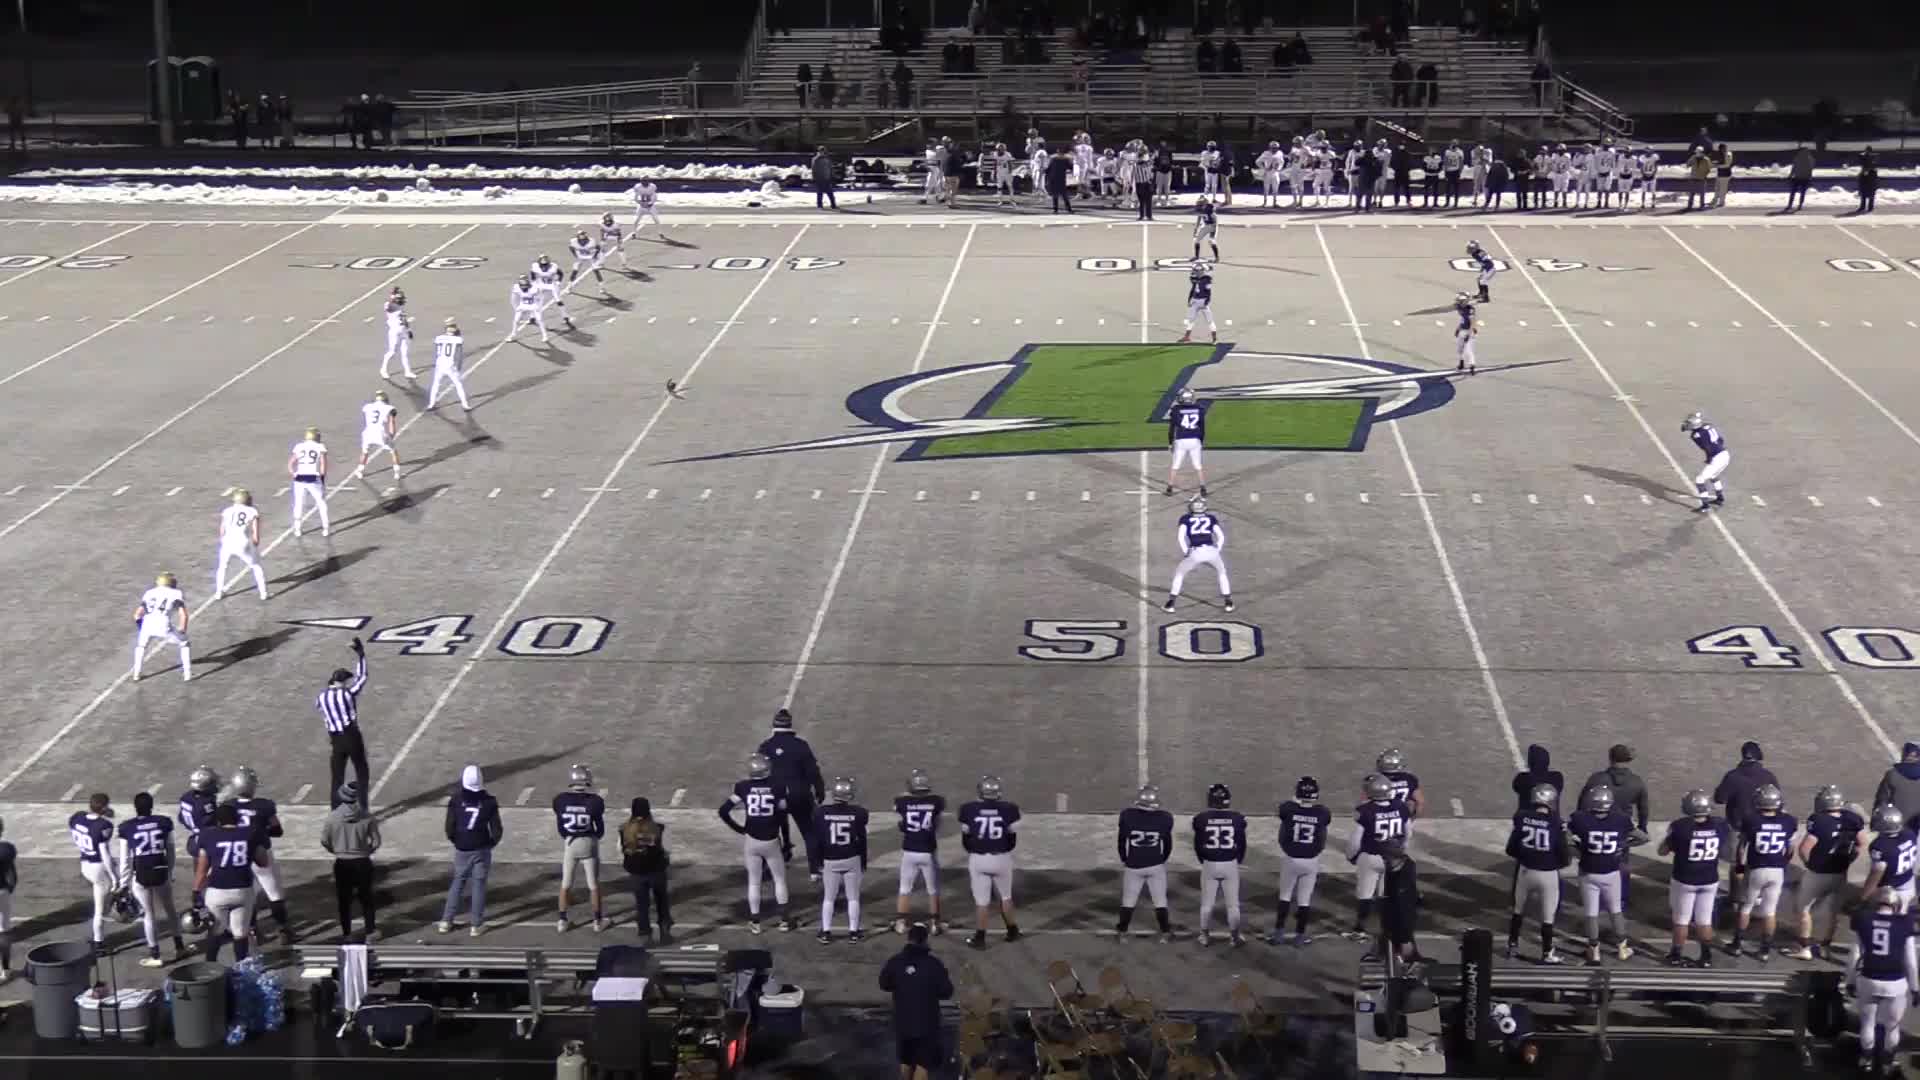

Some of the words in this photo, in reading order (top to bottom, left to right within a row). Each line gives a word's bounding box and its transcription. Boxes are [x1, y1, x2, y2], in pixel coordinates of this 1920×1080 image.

[372, 410, 381, 424] 3
[1180, 414, 1200, 429] 42
[299, 449, 318, 465] 29
[232, 511, 247, 527] 18
[1189, 517, 1211, 534] 22
[367, 615, 615, 656] 40
[1018, 619, 1264, 662] 50
[1686, 626, 1920, 669] 40
[746, 794, 774, 817] 85
[464, 808, 480, 831] 7
[906, 811, 933, 833] 54
[974, 816, 1003, 840] 76
[1375, 817, 1404, 842] 50
[829, 822, 851, 845] 15
[1130, 831, 1159, 847] 23
[1205, 826, 1235, 849] 33
[1292, 822, 1315, 844] 13
[1522, 826, 1550, 852] 20
[1588, 831, 1619, 854] 55
[216, 841, 248, 868] 78
[1871, 928, 1890, 956] 9
